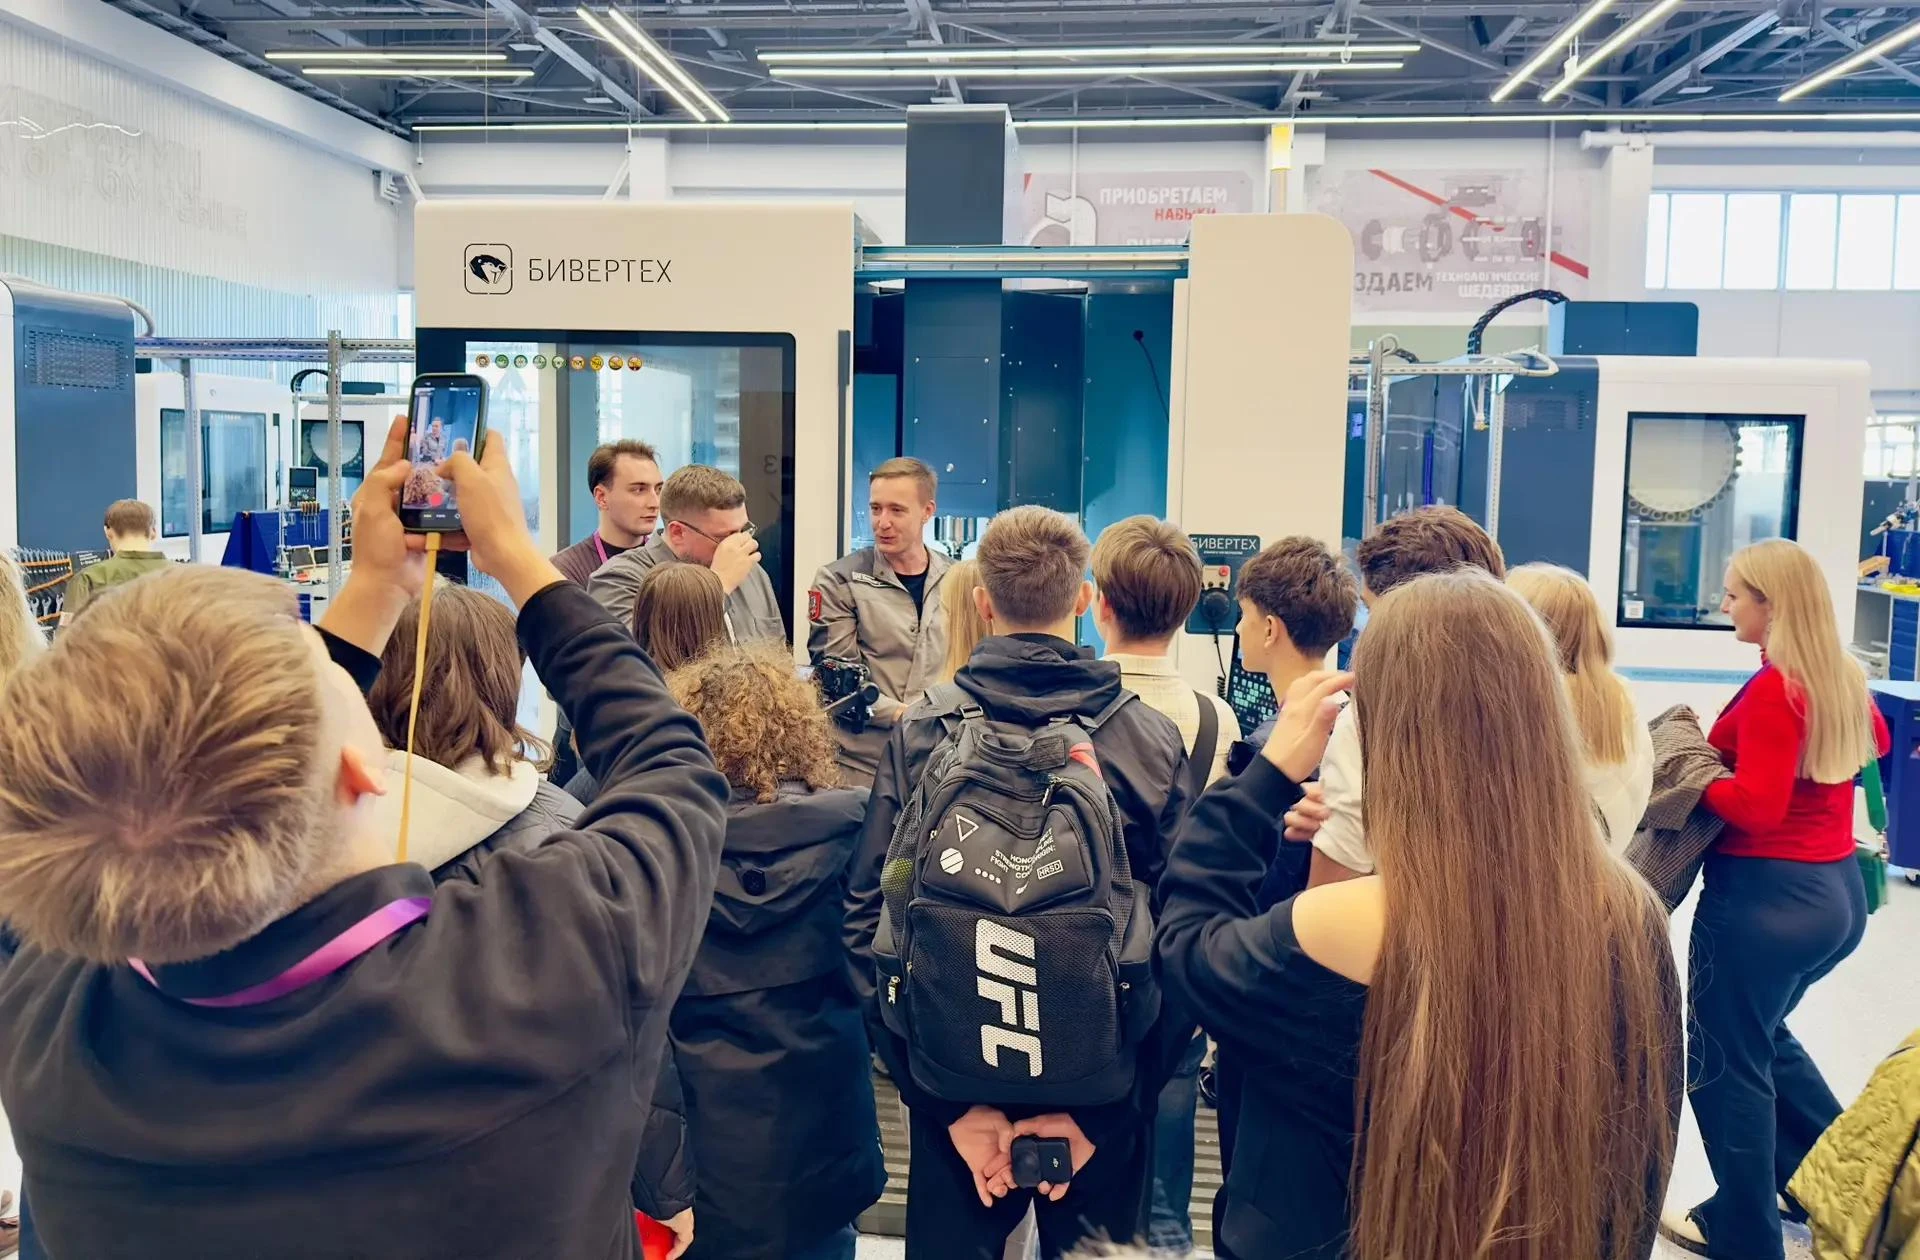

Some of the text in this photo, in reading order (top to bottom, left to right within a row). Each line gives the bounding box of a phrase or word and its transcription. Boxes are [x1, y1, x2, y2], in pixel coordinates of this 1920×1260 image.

[1100, 187, 1227, 205] ПРИОБРЕТАЕМ
[528, 258, 672, 283] БИВЕРТЕХ
[1435, 271, 1540, 283] ТЕХНОЛОГИЧЕСКИЕ
[1190, 537, 1257, 550] БИВЕРТЕХ
[990, 855, 1009, 873] FIGHT
[1039, 862, 1061, 878] HRSD
[976, 919, 1042, 1077] UFC
